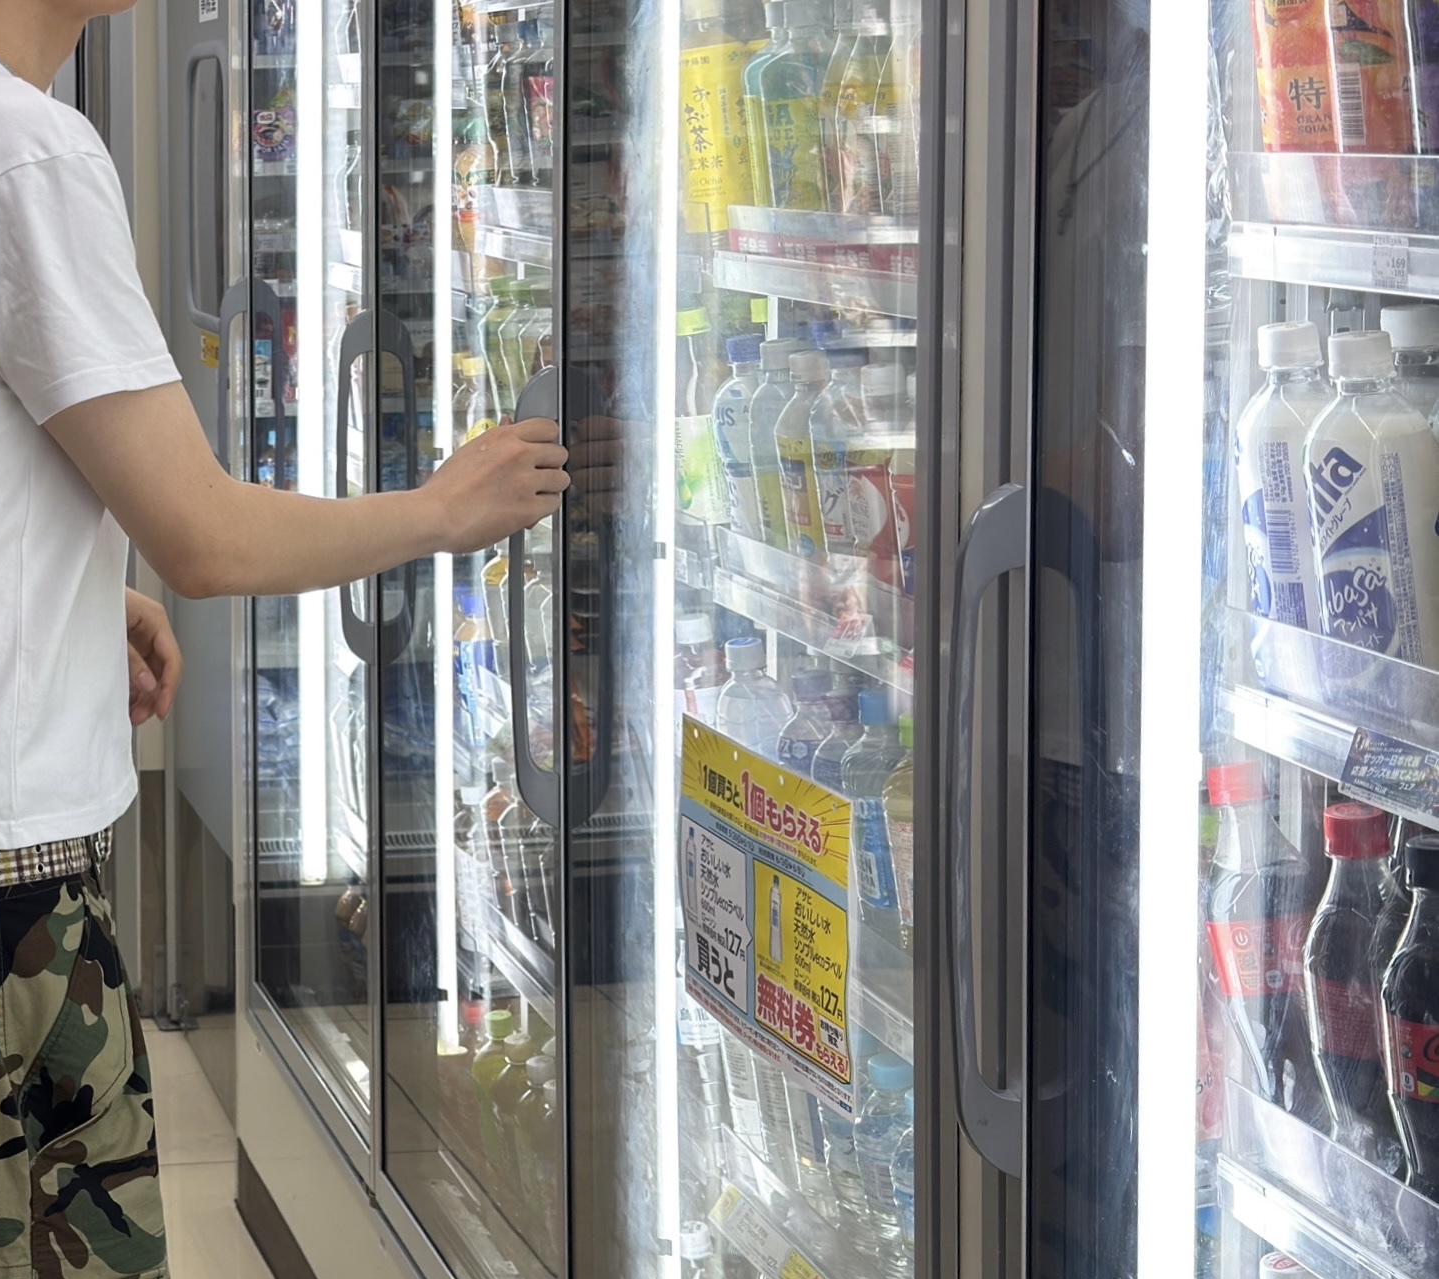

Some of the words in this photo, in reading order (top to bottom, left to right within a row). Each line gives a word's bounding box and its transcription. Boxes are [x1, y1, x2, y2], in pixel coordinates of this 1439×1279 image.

[1287, 76, 1327, 111] 特
[1333, 606, 1379, 636] アンバサ
[1399, 782, 1415, 790] フェア
[700, 835, 715, 851] アサヒ
[700, 864, 720, 888] 天然水
[701, 848, 732, 878] おいしい水
[795, 886, 812, 905] アサヒ
[793, 918, 816, 944] 天然水
[794, 902, 832, 934] おいしい水
[696, 932, 736, 1000] 買うと
[794, 936, 843, 980] シンプルecoラベル
[794, 954, 811, 974] 600ml
[755, 972, 817, 1052] 無料券
[815, 1042, 849, 1080] もらえる!
